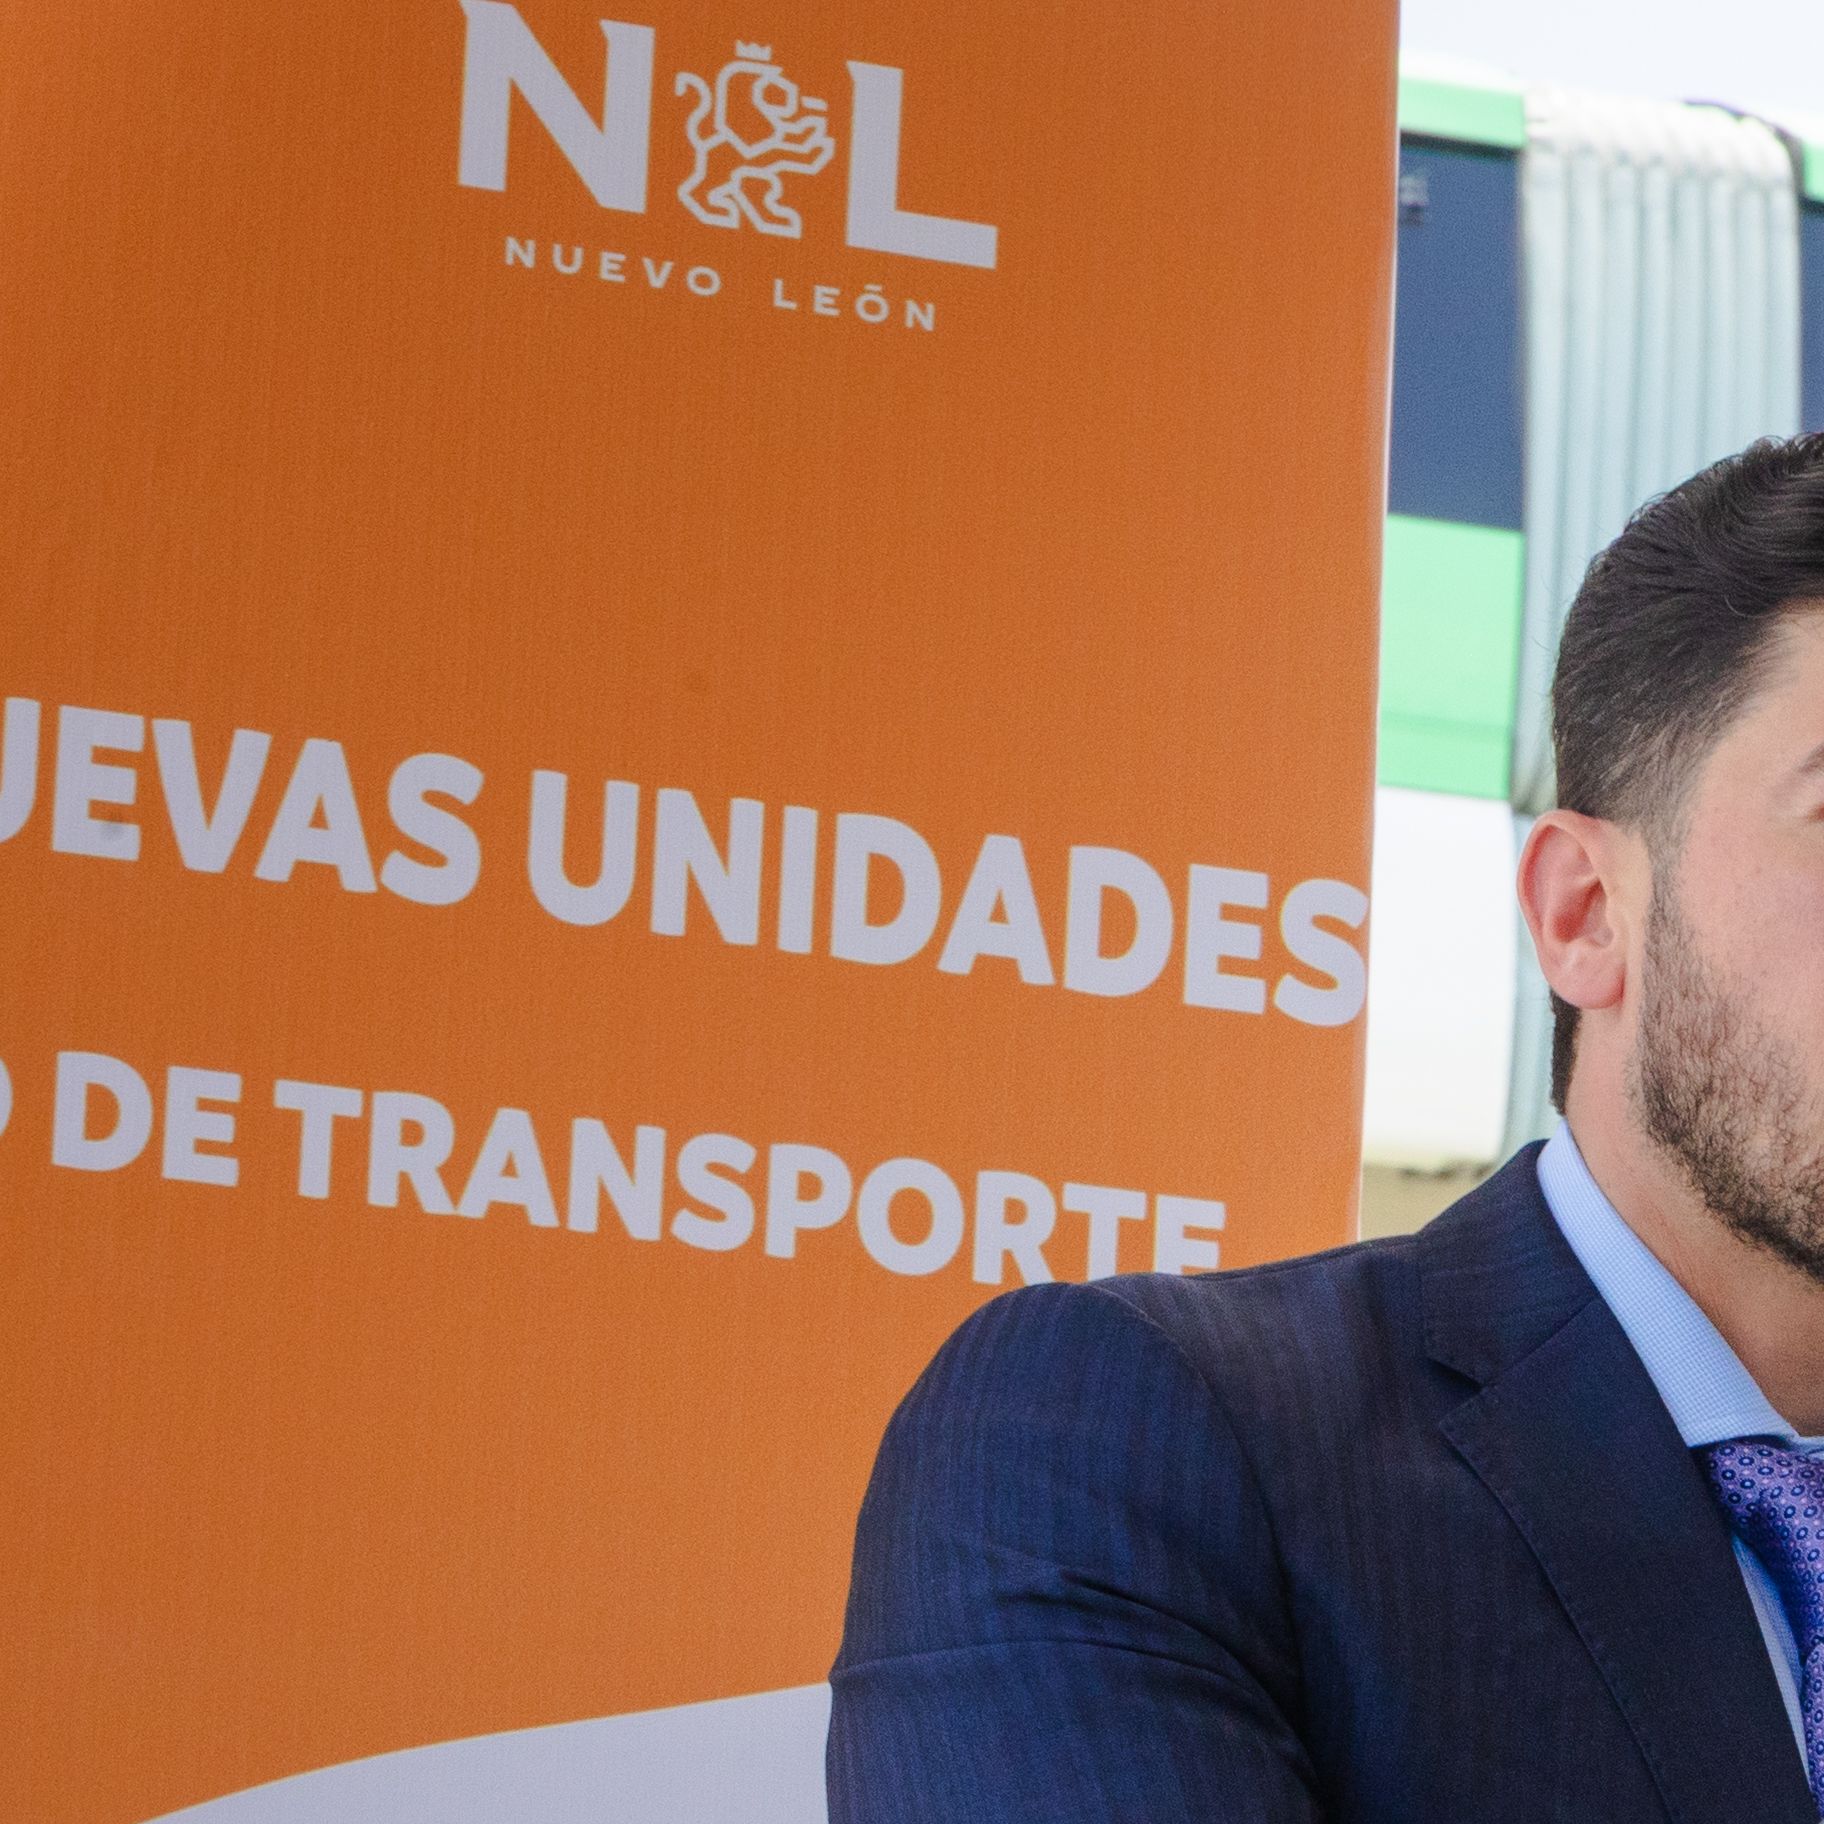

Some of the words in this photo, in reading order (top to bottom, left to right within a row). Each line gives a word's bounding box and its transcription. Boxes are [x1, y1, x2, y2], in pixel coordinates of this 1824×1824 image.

[505, 237, 721, 296] NUEVO
[527, 769, 1371, 1028] UNIDADES
[52, 1051, 242, 1186] DE
[274, 1079, 1226, 1287] TRANSPORTE
